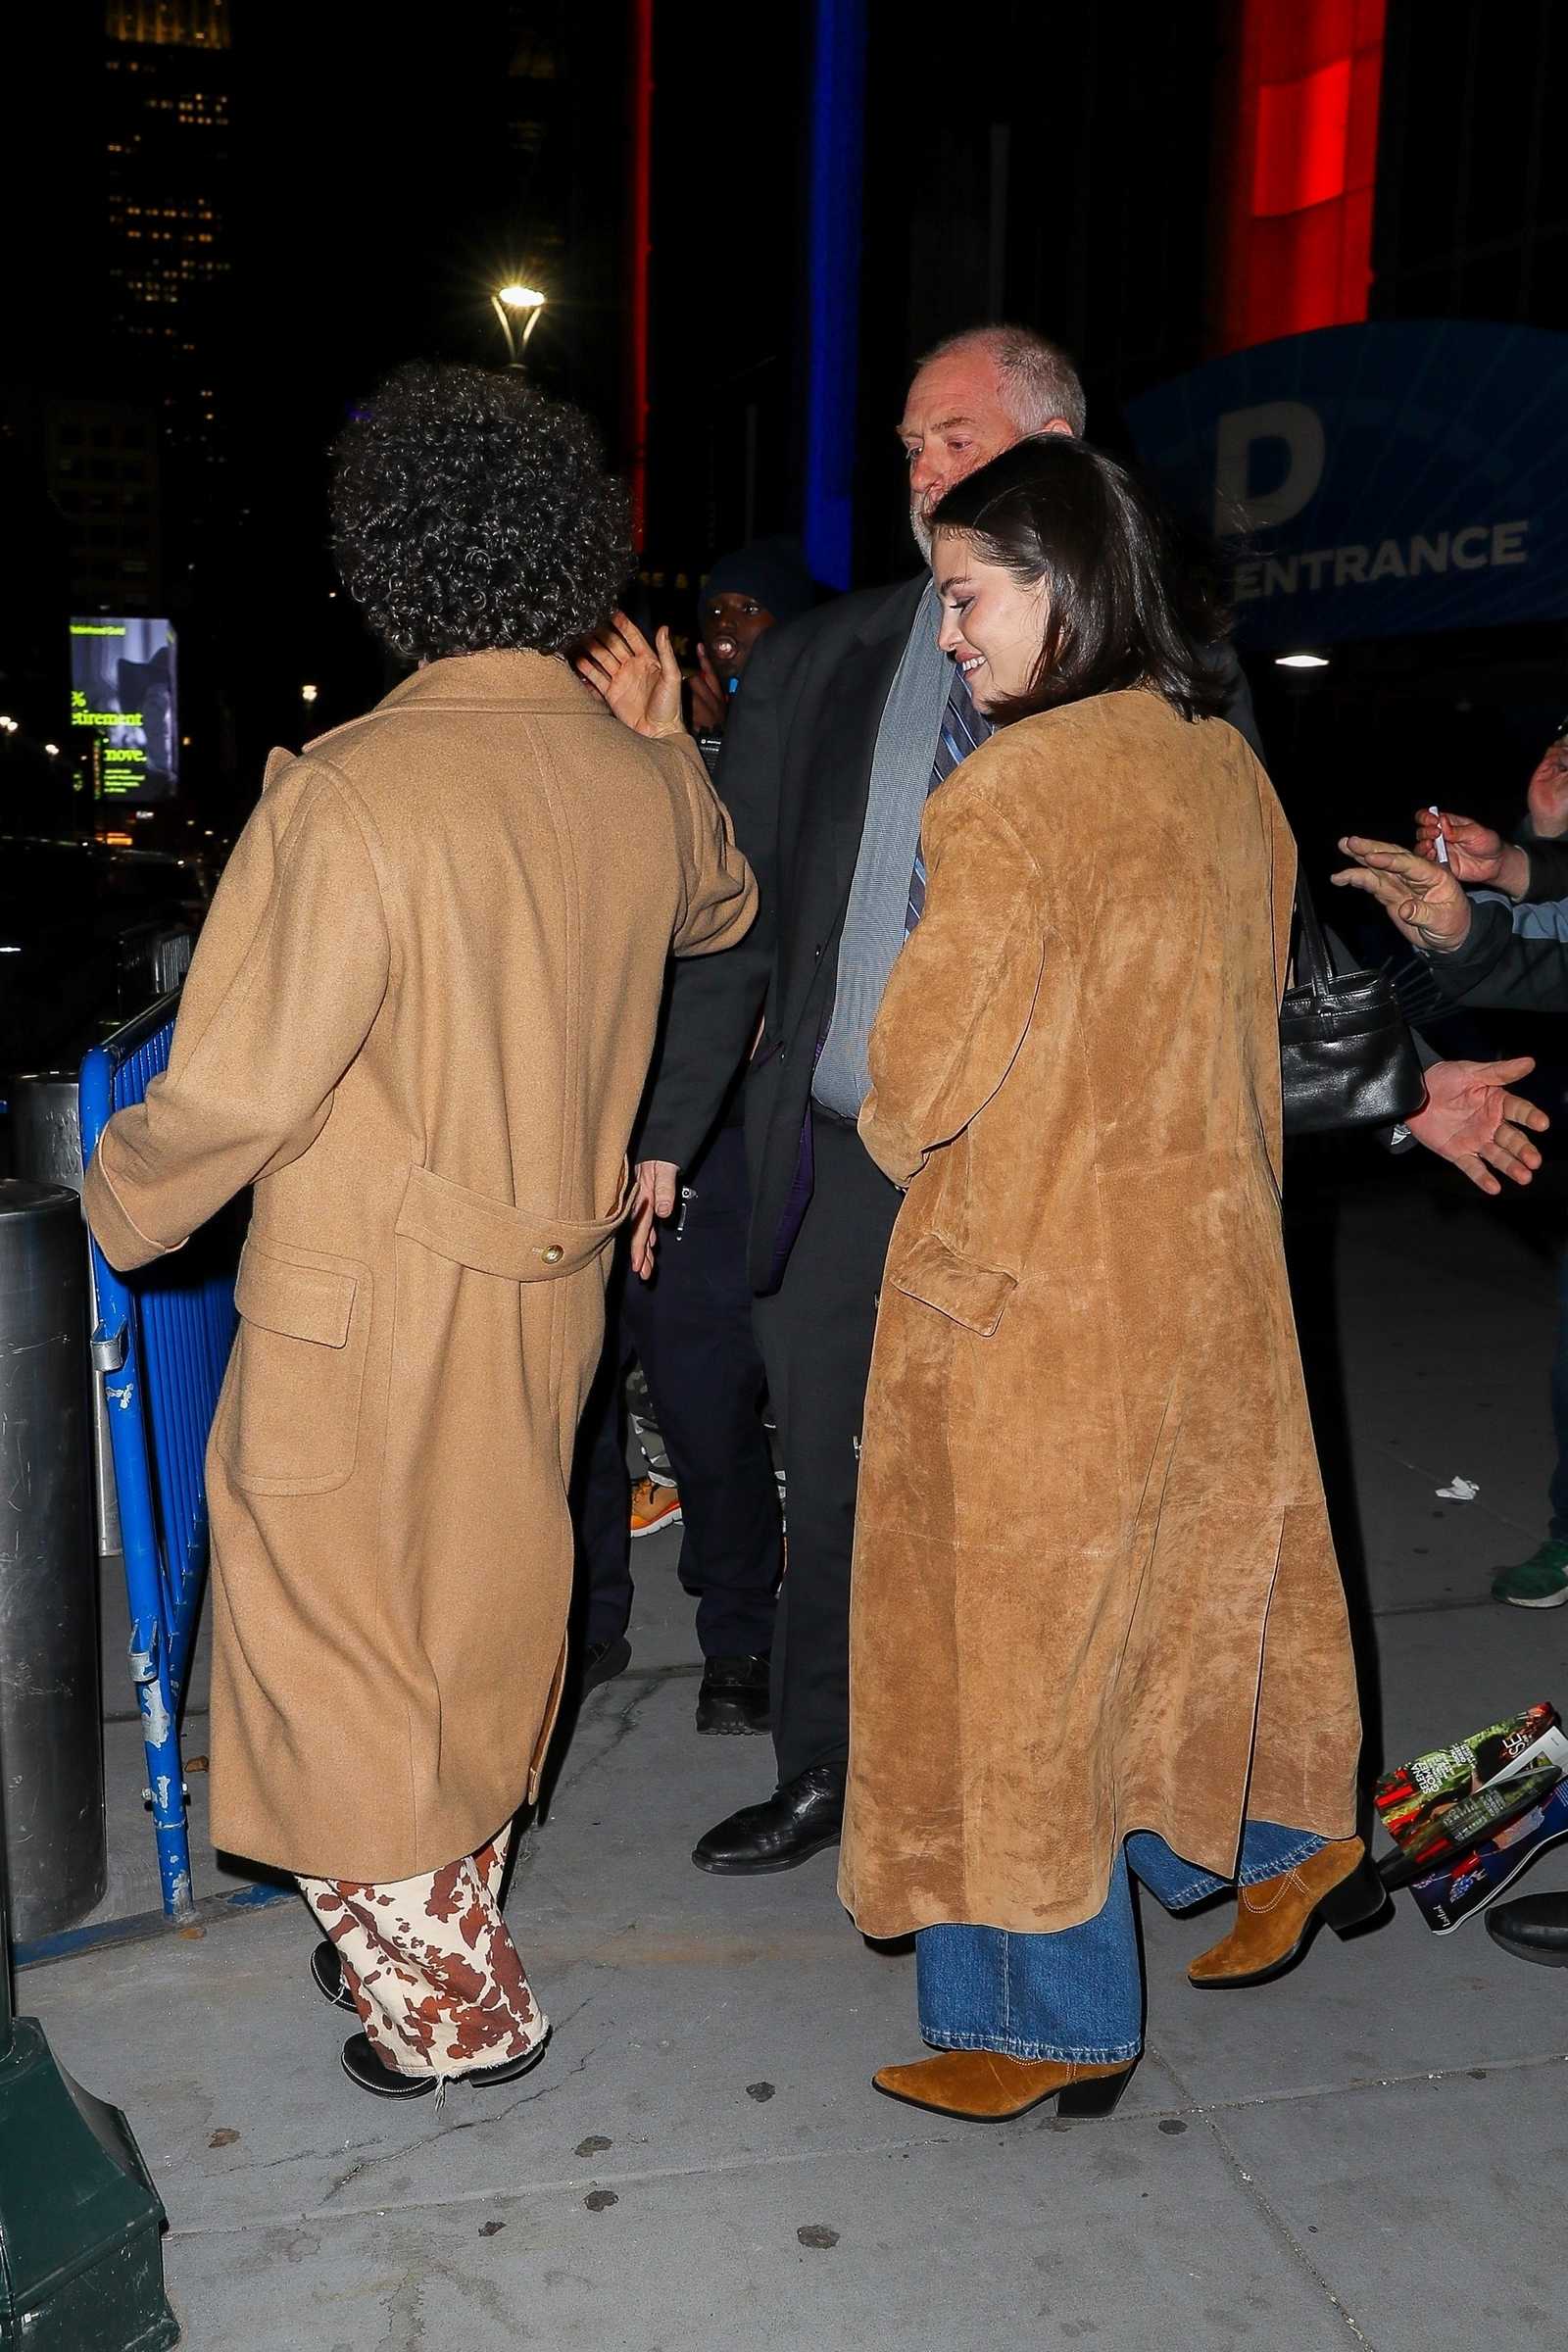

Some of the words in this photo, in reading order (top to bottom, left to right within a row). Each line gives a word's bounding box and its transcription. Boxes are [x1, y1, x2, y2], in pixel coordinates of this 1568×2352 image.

[1214, 400, 1326, 537] D
[1232, 520, 1530, 603] ENTRANCE
[1410, 1761, 1432, 1794] SELENA
[1419, 1760, 1440, 1792] GOMEZ
